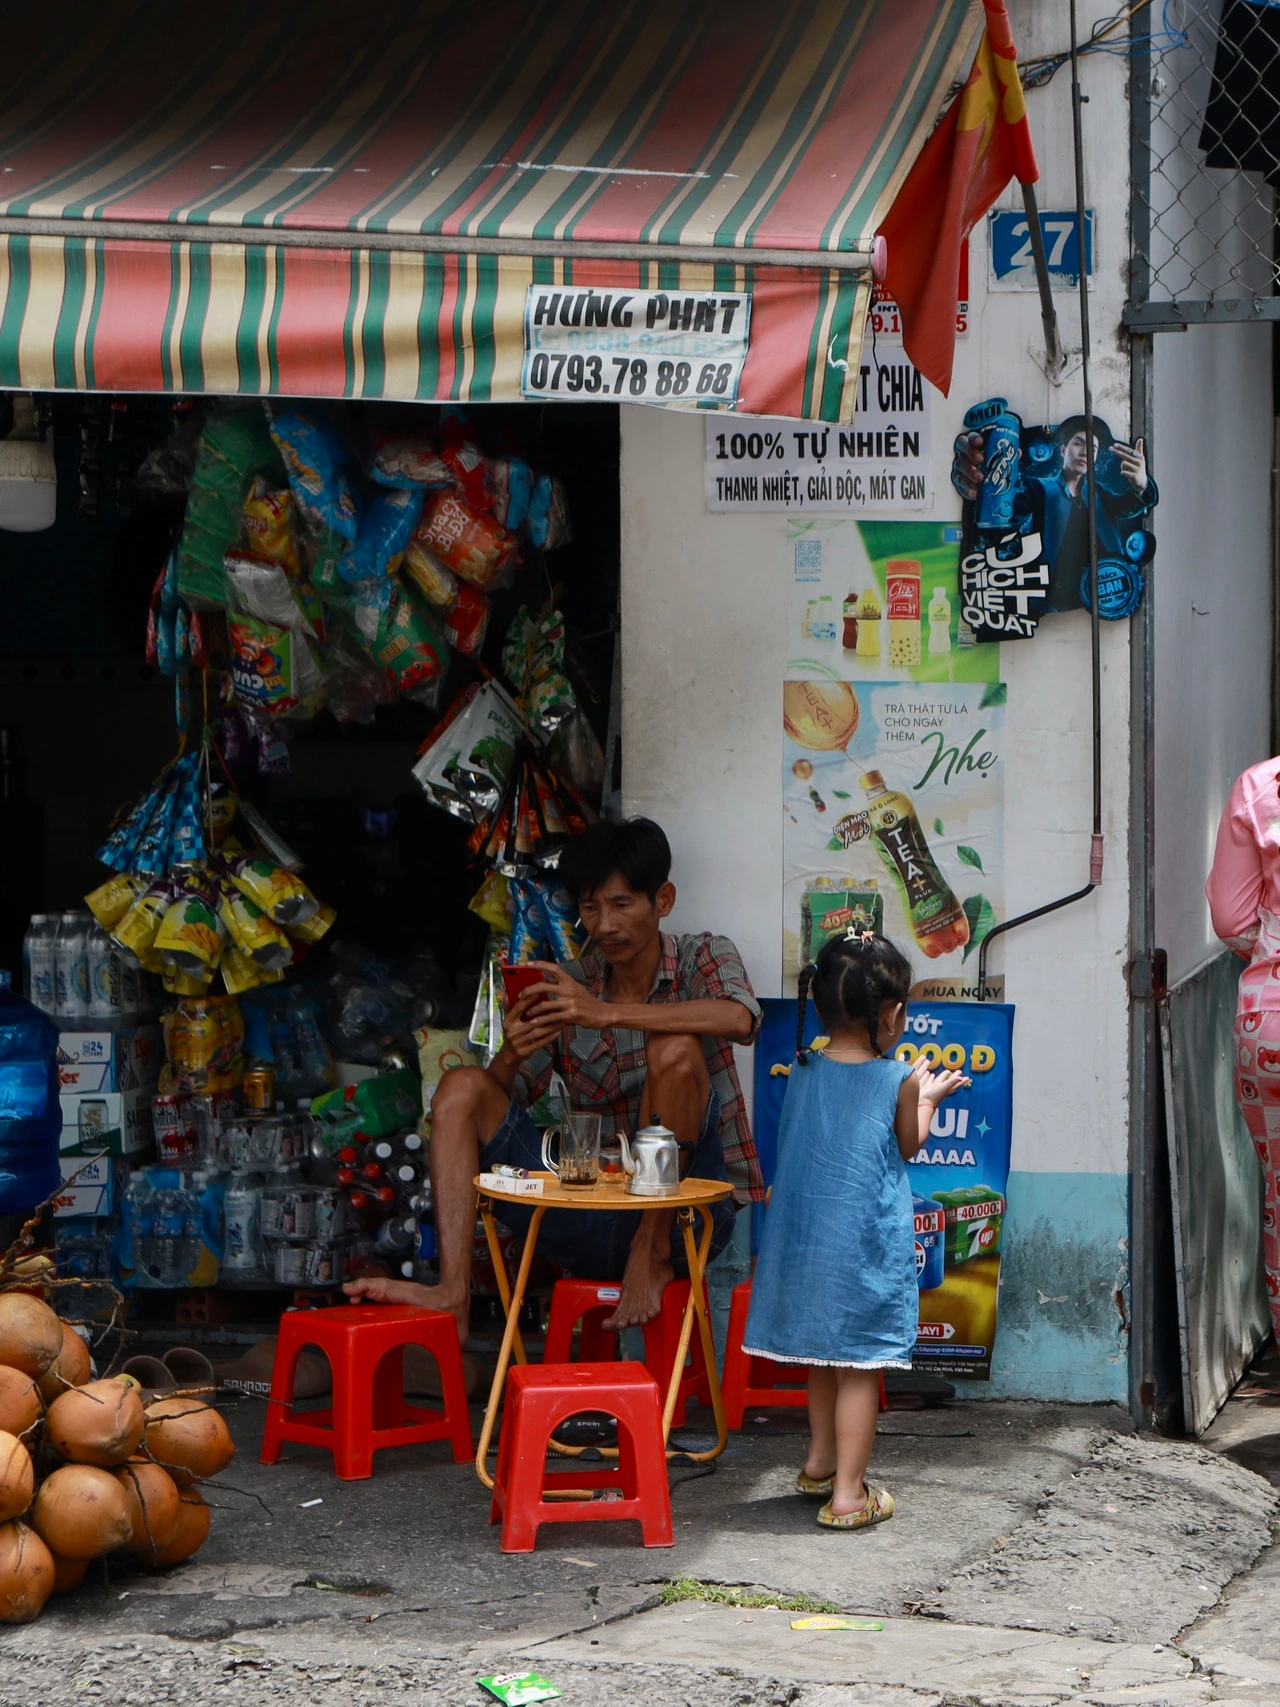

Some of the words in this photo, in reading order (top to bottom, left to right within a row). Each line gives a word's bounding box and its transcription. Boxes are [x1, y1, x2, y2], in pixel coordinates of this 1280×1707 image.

[1011, 221, 1074, 266] 27
[534, 289, 635, 328] HƯNG
[530, 353, 647, 396] 0793.78
[655, 360, 693, 397] 88
[696, 363, 733, 395] 68
[877, 364, 924, 413] CHIA
[715, 431, 785, 460] 100%
[793, 427, 830, 464] TỰ
[839, 424, 920, 458] NHIÊN
[991, 445, 1015, 486] STING
[716, 476, 758, 501] THANH
[762, 471, 804, 506] NHIỆT,
[807, 467, 832, 501] GIẢI
[836, 471, 866, 506] ĐỘC,
[869, 469, 897, 501] MÁT
[900, 475, 926, 500] GAN
[418, 495, 464, 545] Snack
[961, 531, 1043, 574] CÚ
[889, 579, 915, 599] Ciao
[961, 564, 1050, 590] HÍCH
[963, 586, 1046, 616] VIỆT
[884, 702, 906, 714] TRÀ
[908, 702, 936, 717] THẬT
[938, 702, 954, 715] TỪ
[954, 702, 968, 714] LÁ
[884, 717, 911, 728] CHO
[913, 716, 945, 728] NGÀY
[885, 730, 915, 742] THÊM
[912, 728, 999, 790] Nhẹ
[922, 986, 957, 998] MUA
[90, 1041, 103, 1051] 24
[524, 1183, 538, 1191] JET
